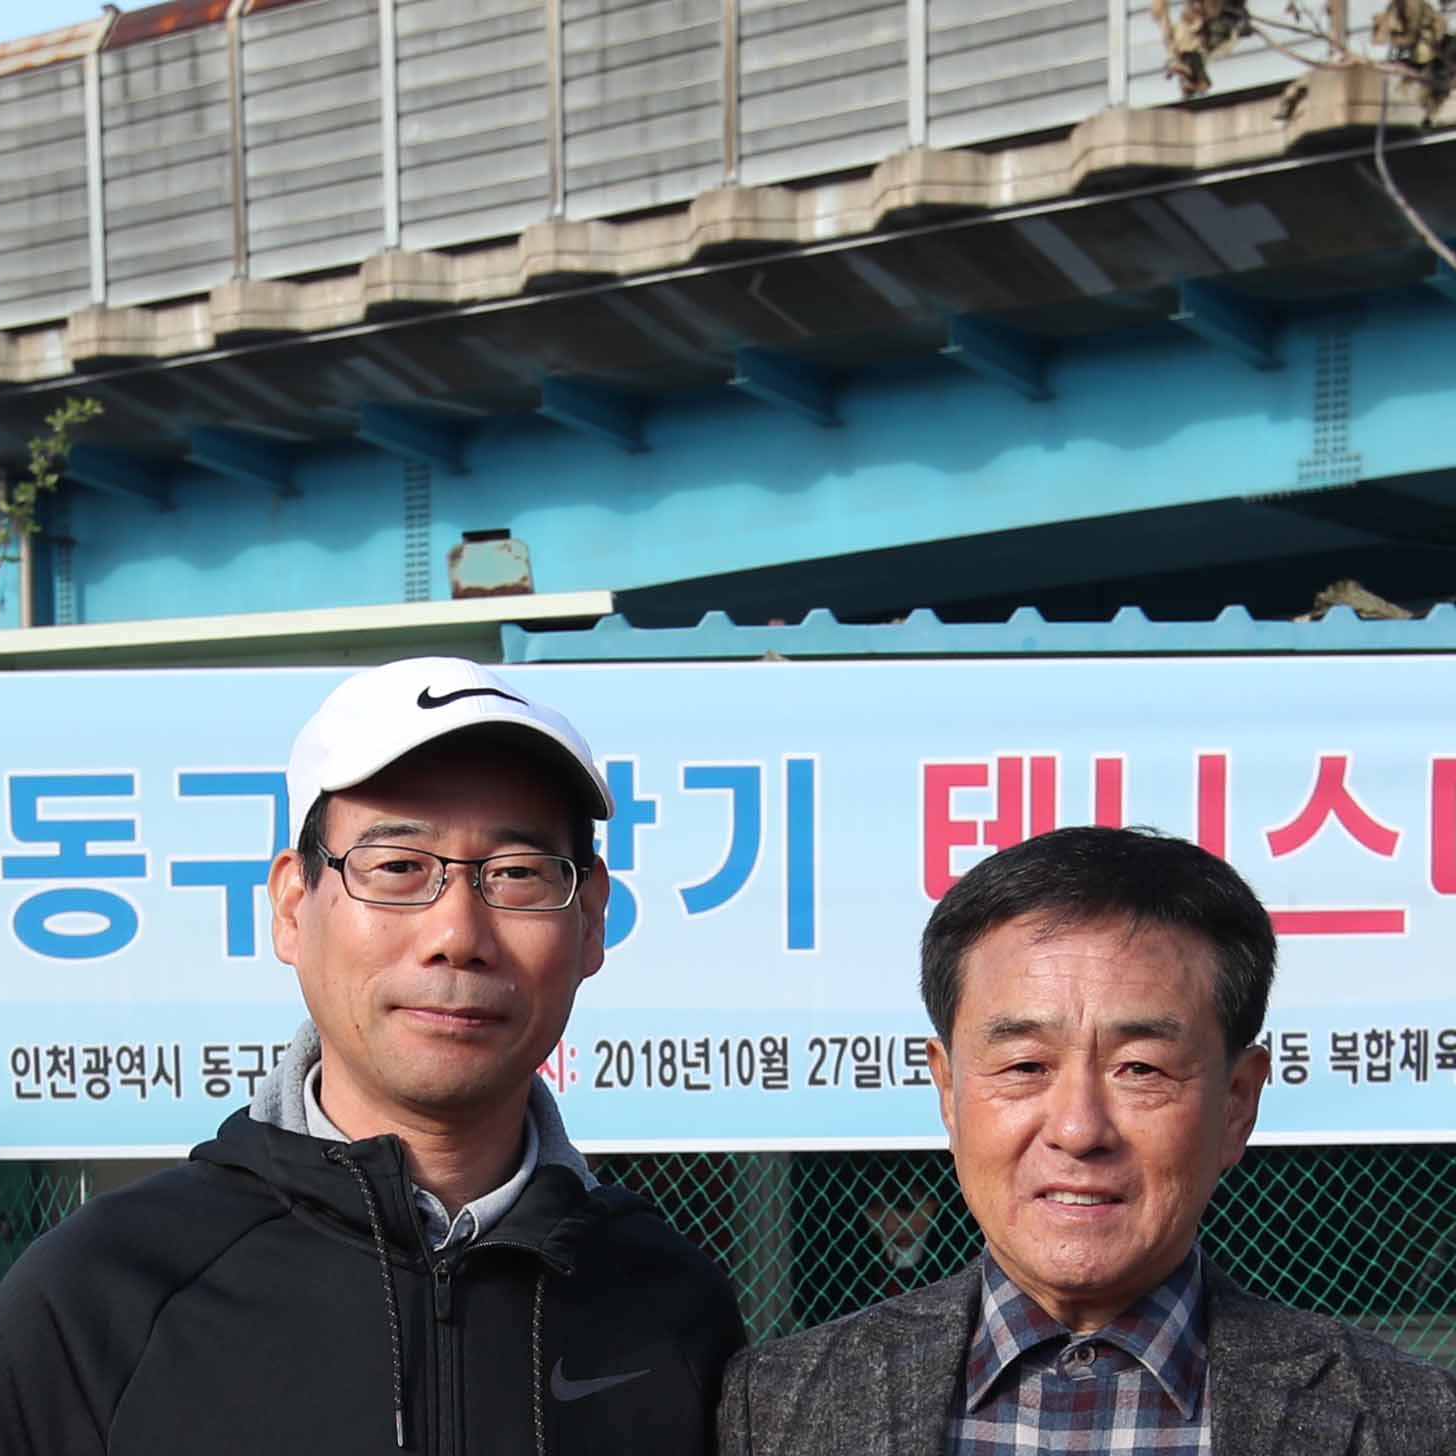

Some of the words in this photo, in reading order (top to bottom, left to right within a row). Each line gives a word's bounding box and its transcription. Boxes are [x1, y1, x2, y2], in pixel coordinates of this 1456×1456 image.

[1, 758, 814, 960] 동구기
[10, 1044, 182, 1100] 인천광역시
[201, 1043, 292, 1098] 동구
[594, 1036, 791, 1091] 2018년10월
